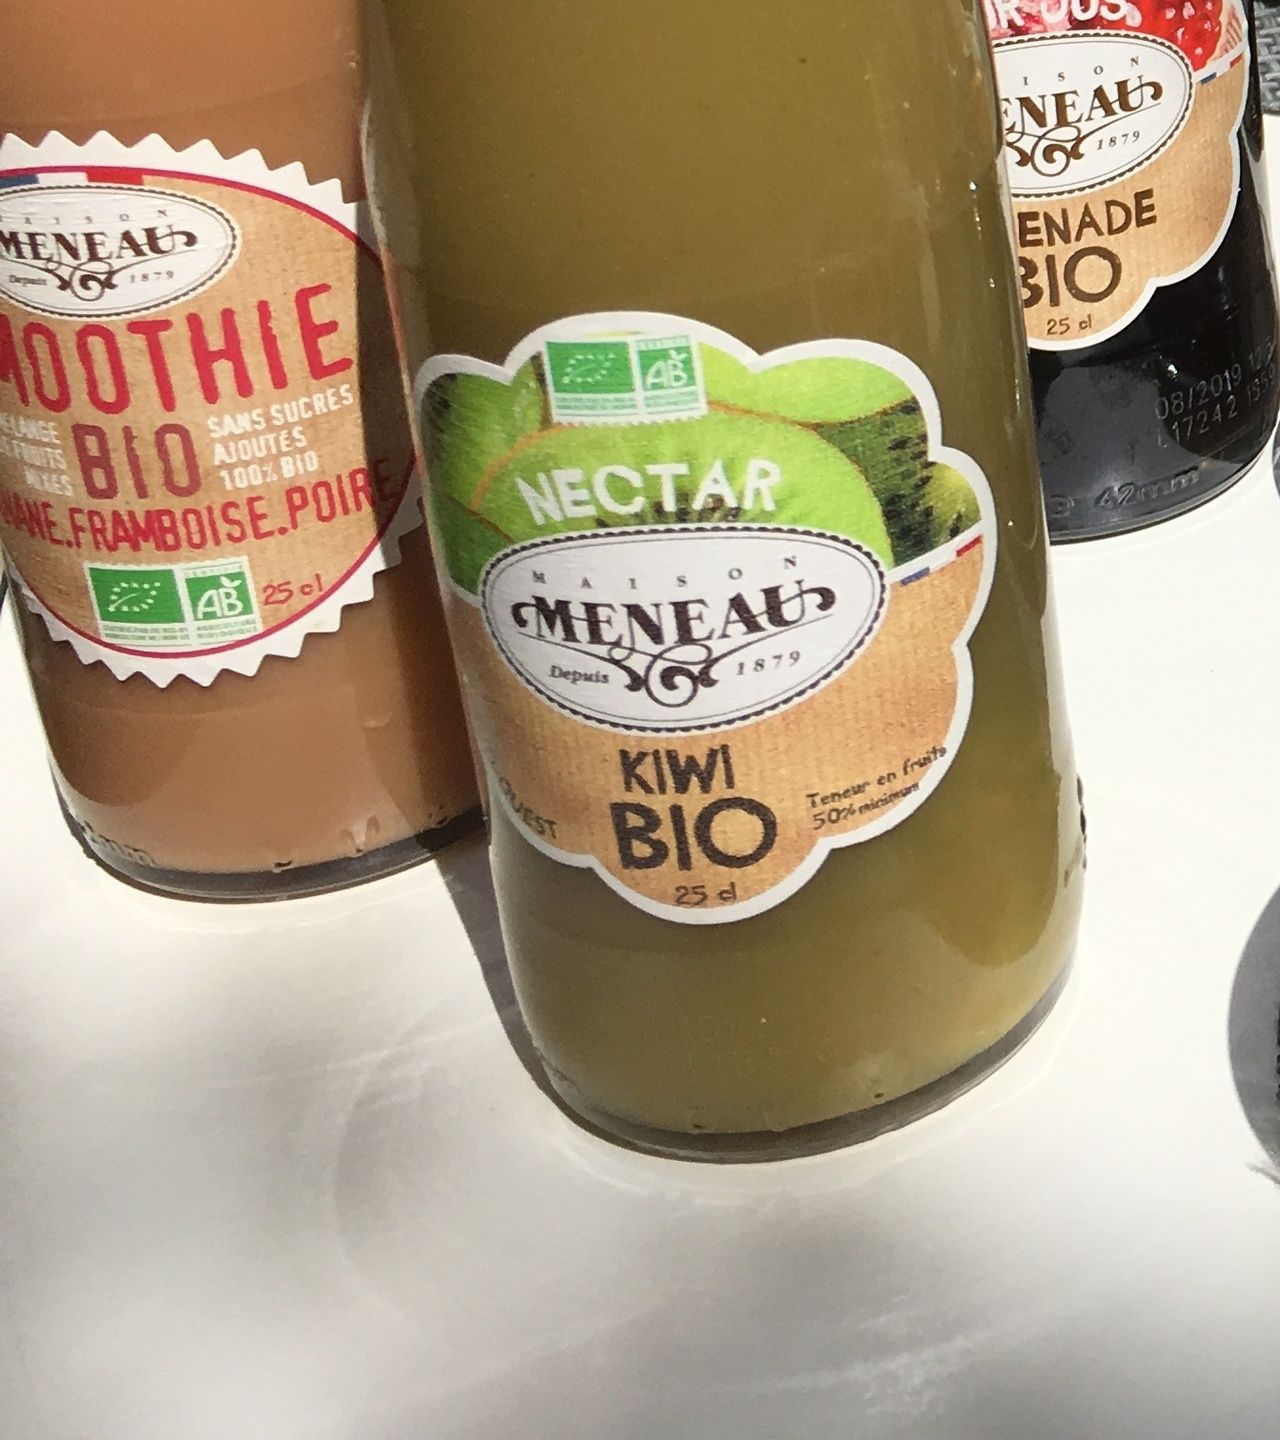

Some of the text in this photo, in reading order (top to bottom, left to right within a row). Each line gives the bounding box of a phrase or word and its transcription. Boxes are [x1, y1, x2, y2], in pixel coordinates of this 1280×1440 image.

[1096, 130, 1141, 150] 1879
[1017, 188, 1158, 248] ENADE
[129, 270, 175, 284] 1879
[1046, 313, 1092, 336] 25 cl
[207, 383, 354, 439] SANS SUCRES
[1154, 363, 1242, 420] 08/2019
[71, 423, 203, 500] BIO
[219, 450, 320, 492] 100% BIO
[513, 457, 783, 527] NECTAR
[262, 572, 324, 606] 25 cl
[531, 554, 799, 590] MAISON
[510, 579, 837, 650] MENEAU
[549, 650, 802, 687] Depuis 1879
[618, 744, 735, 796] KIWI
[805, 745, 948, 810] Teneur en fruits
[609, 796, 778, 872] BIO
[811, 802, 858, 832] 50%
[674, 884, 708, 906] 25
